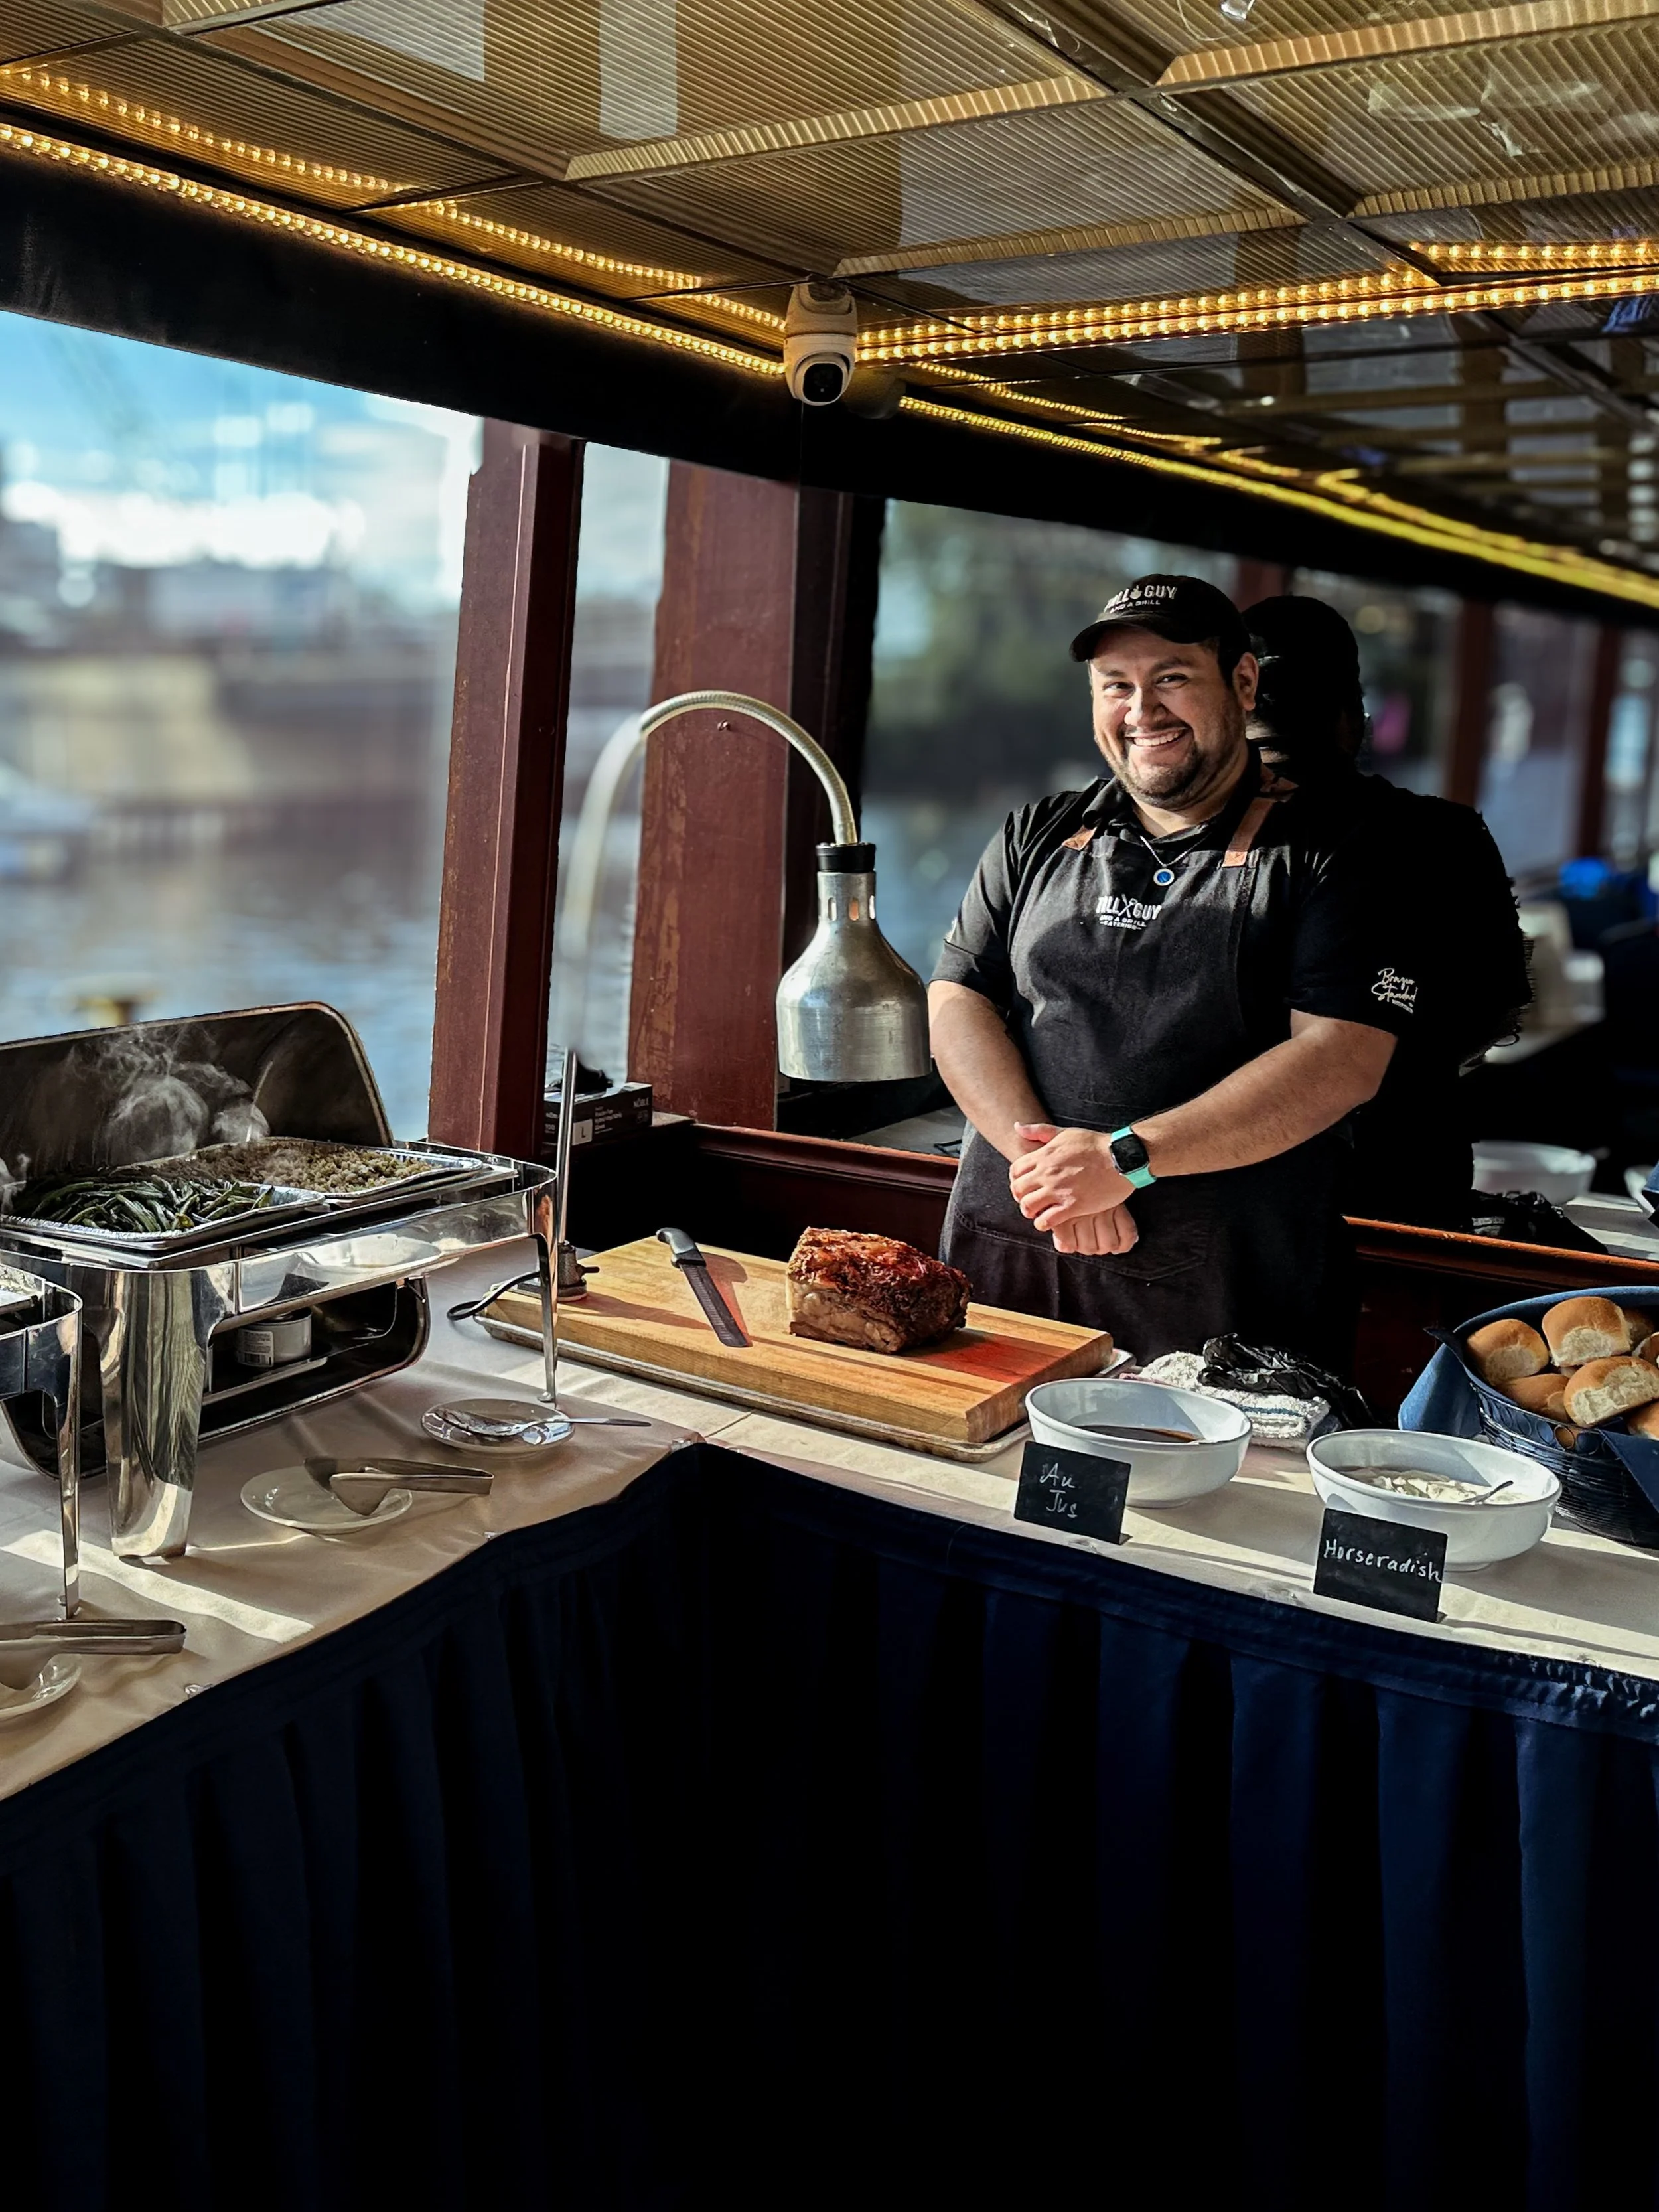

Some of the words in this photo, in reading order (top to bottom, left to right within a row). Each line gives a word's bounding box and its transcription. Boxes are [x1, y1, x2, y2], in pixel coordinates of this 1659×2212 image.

[1144, 585, 1177, 599] GUY
[1133, 902, 1162, 921] GUY
[580, 1126, 586, 1138] L
[1039, 1463, 1075, 1488] Au
[1046, 1489, 1078, 1518] Jus
[1323, 1538, 1443, 1583] Horseradish
